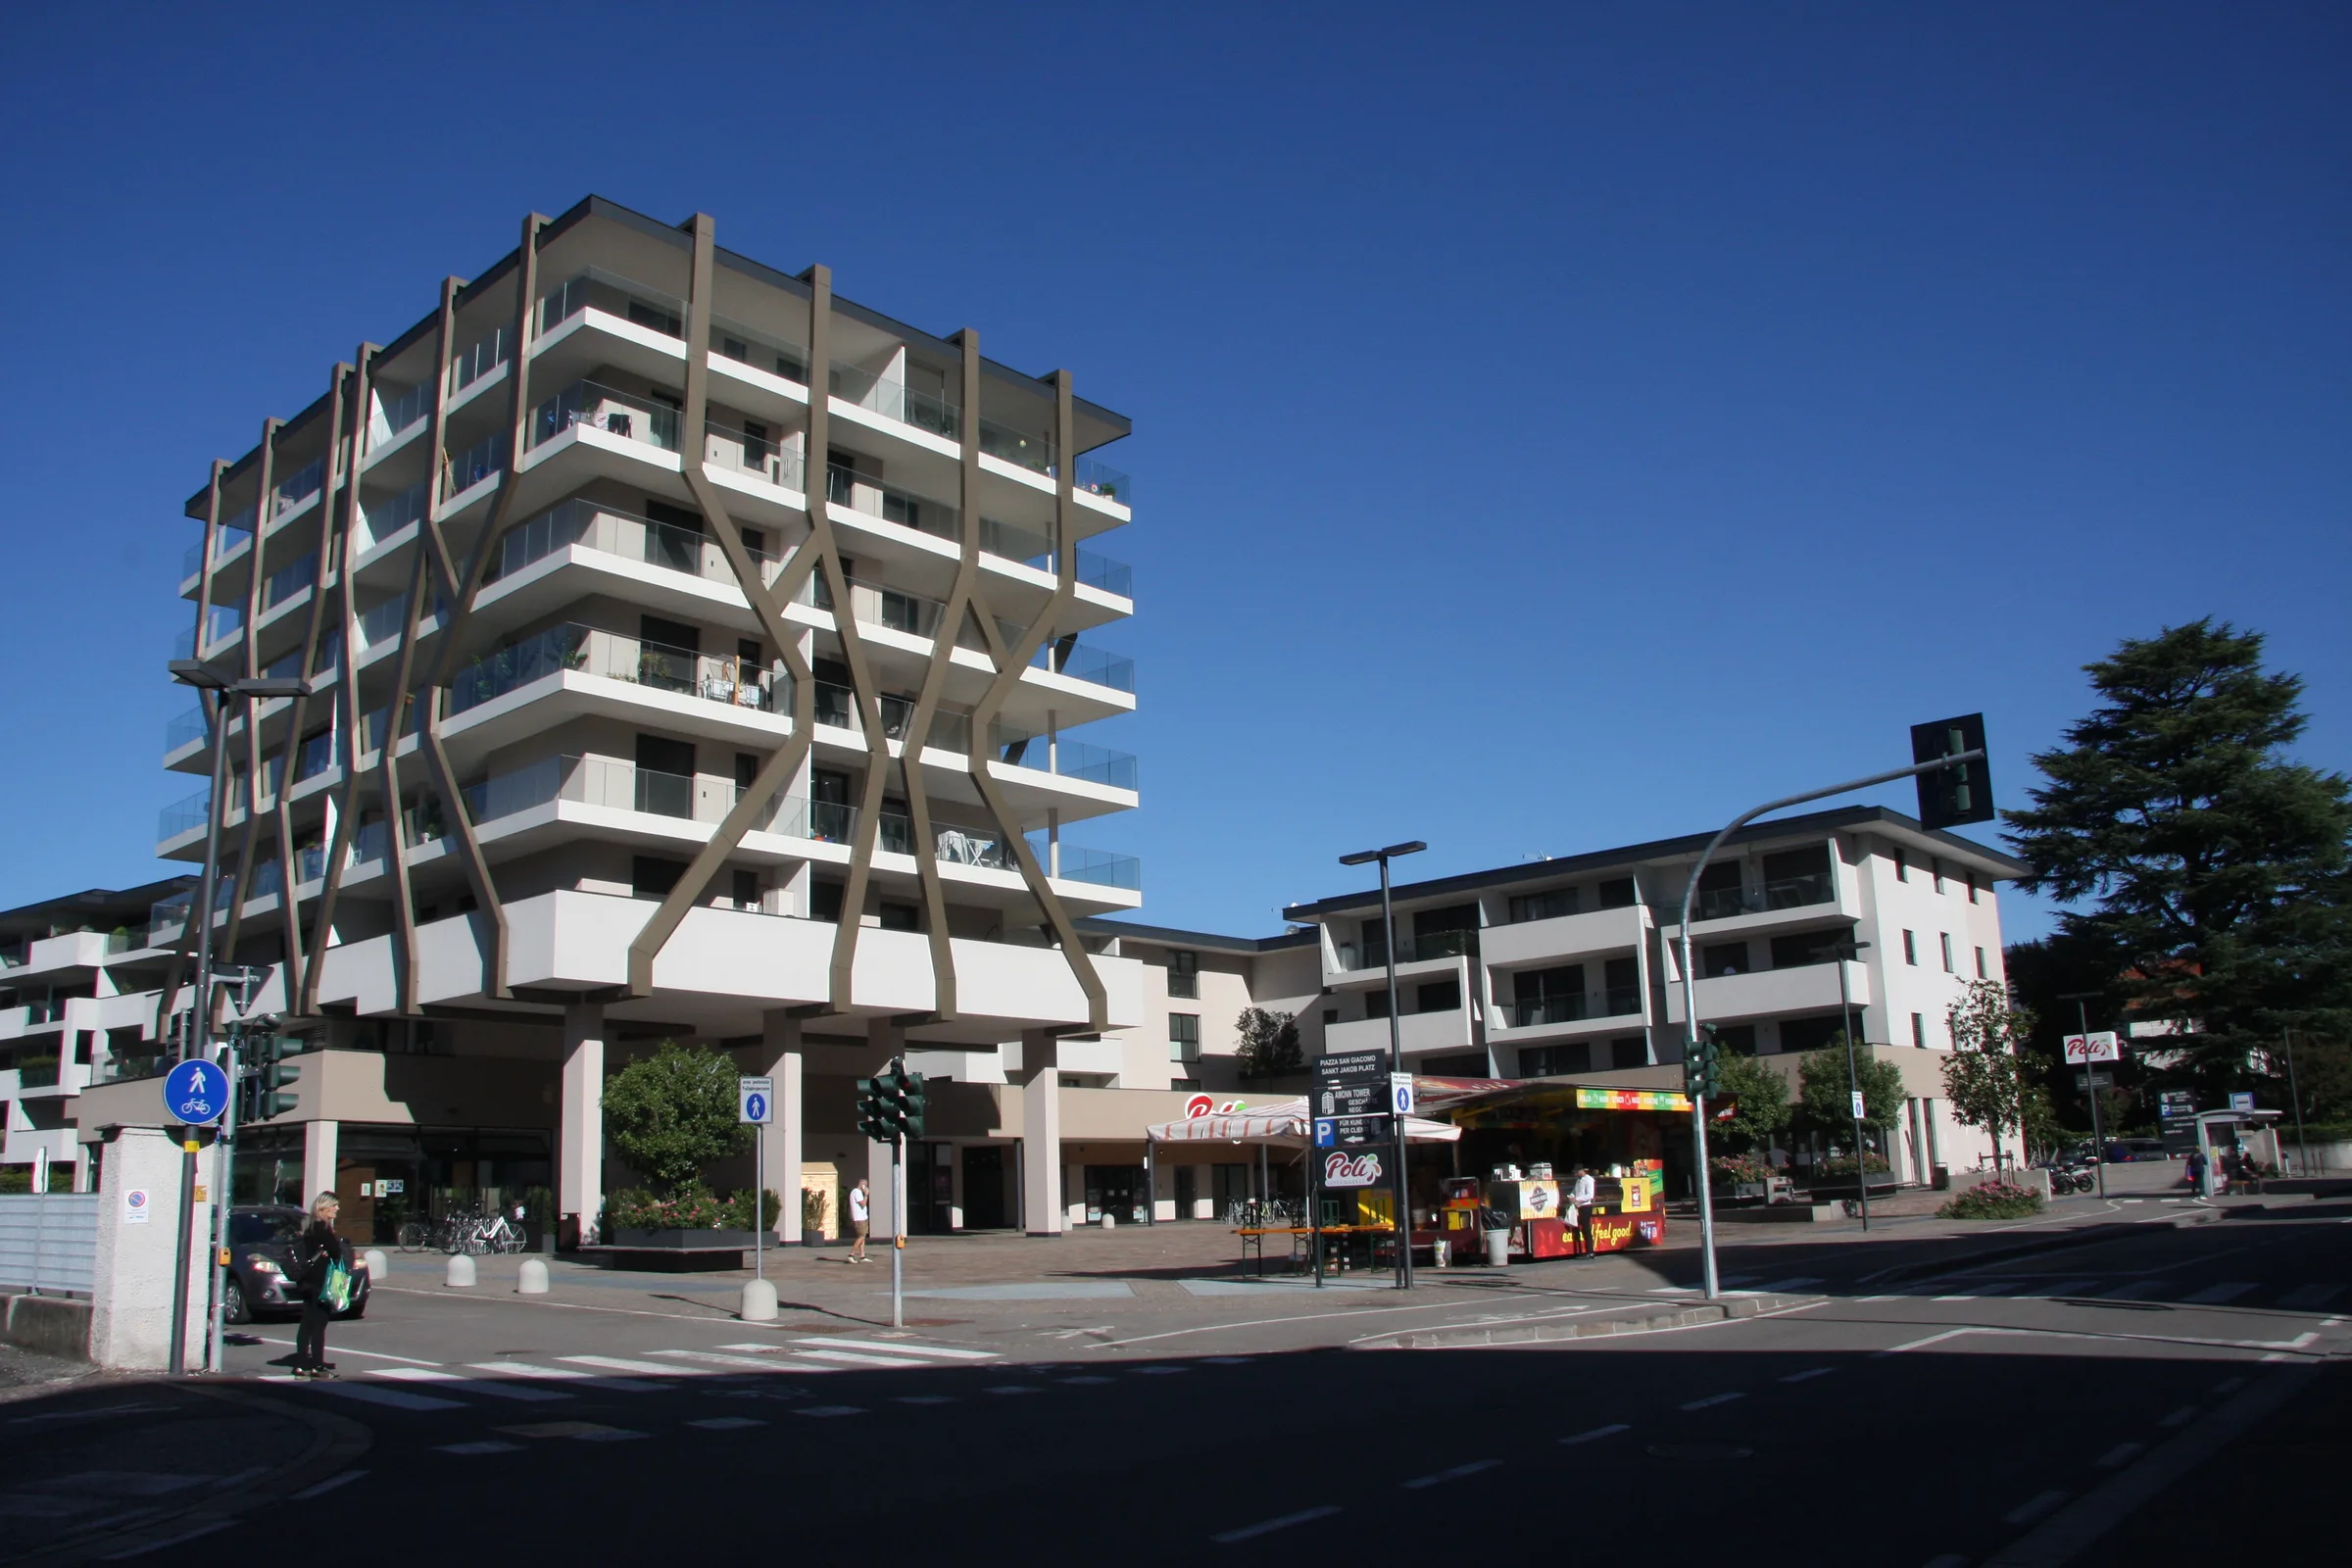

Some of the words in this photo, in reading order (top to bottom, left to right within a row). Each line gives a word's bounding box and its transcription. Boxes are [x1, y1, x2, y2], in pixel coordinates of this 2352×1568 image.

[1350, 1054, 1376, 1063] GIACOMO
[1335, 1090, 1352, 1099] AMONN
[1352, 1088, 1370, 1098] TOWER
[2161, 1104, 2170, 1115] P
[1317, 1122, 1331, 1145] P
[1327, 1152, 1368, 1179] Poli
[1593, 1222, 1611, 1252] feel
